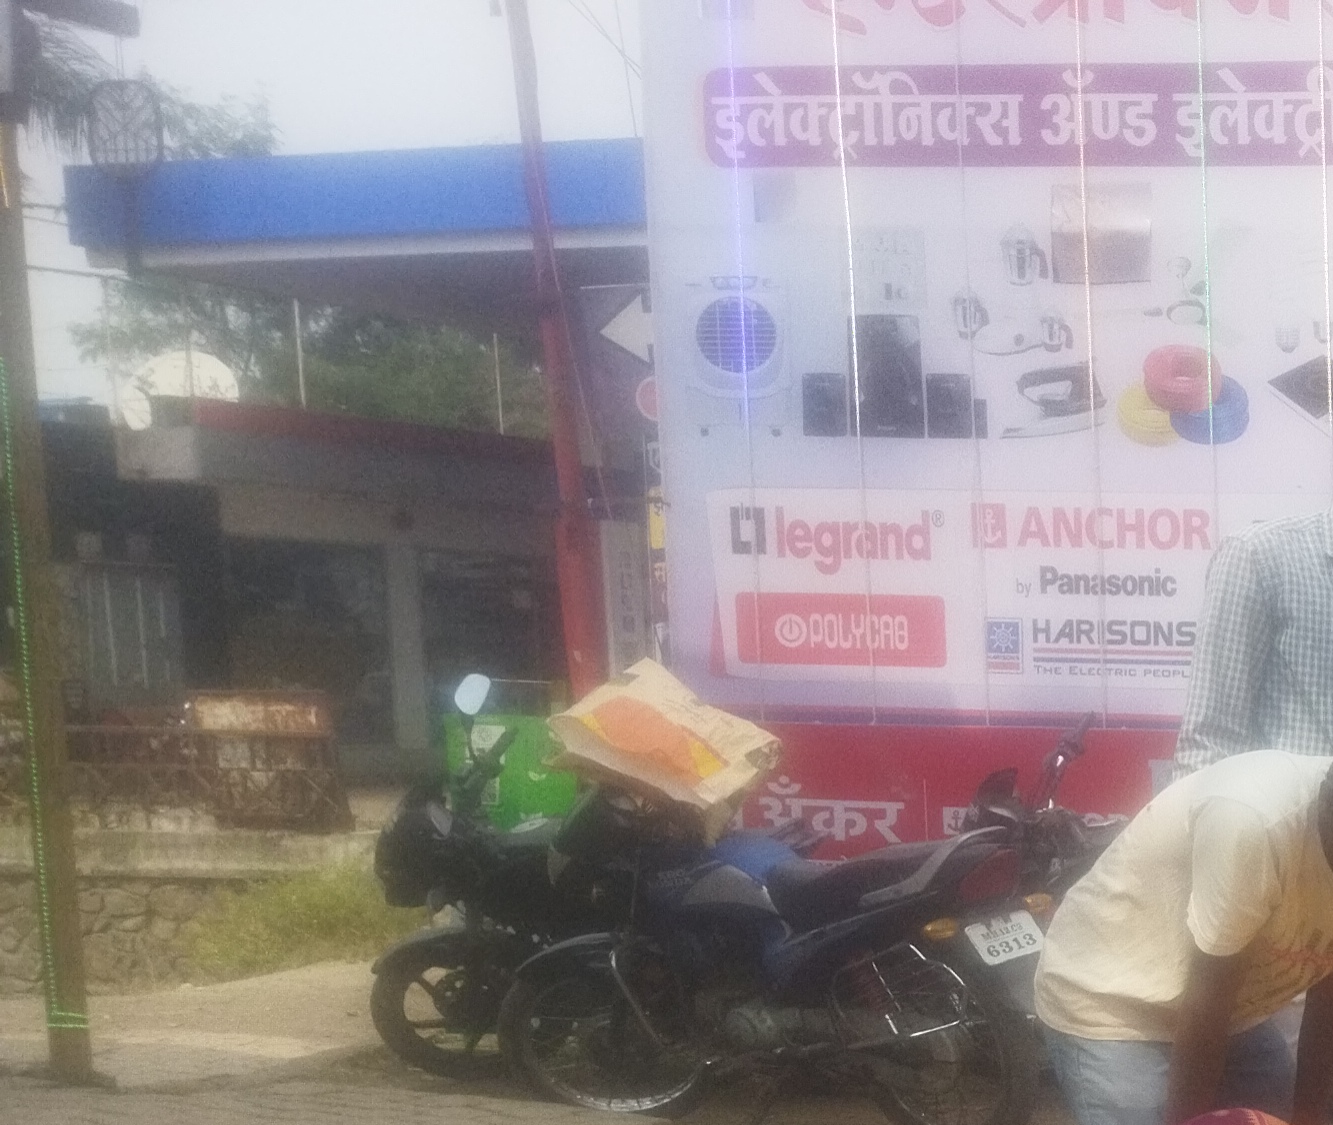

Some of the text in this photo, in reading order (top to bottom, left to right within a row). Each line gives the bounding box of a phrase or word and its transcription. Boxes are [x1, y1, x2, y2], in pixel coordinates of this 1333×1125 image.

[1016, 506, 1212, 550] ANCHOR
[1016, 565, 1178, 598] by Panasonic
[809, 613, 909, 650] POLYCAB
[1031, 618, 1198, 648] HARISONS
[1033, 664, 1062, 676] THE
[1143, 667, 1191, 679] PEOPL
[986, 932, 1038, 958] 6313
